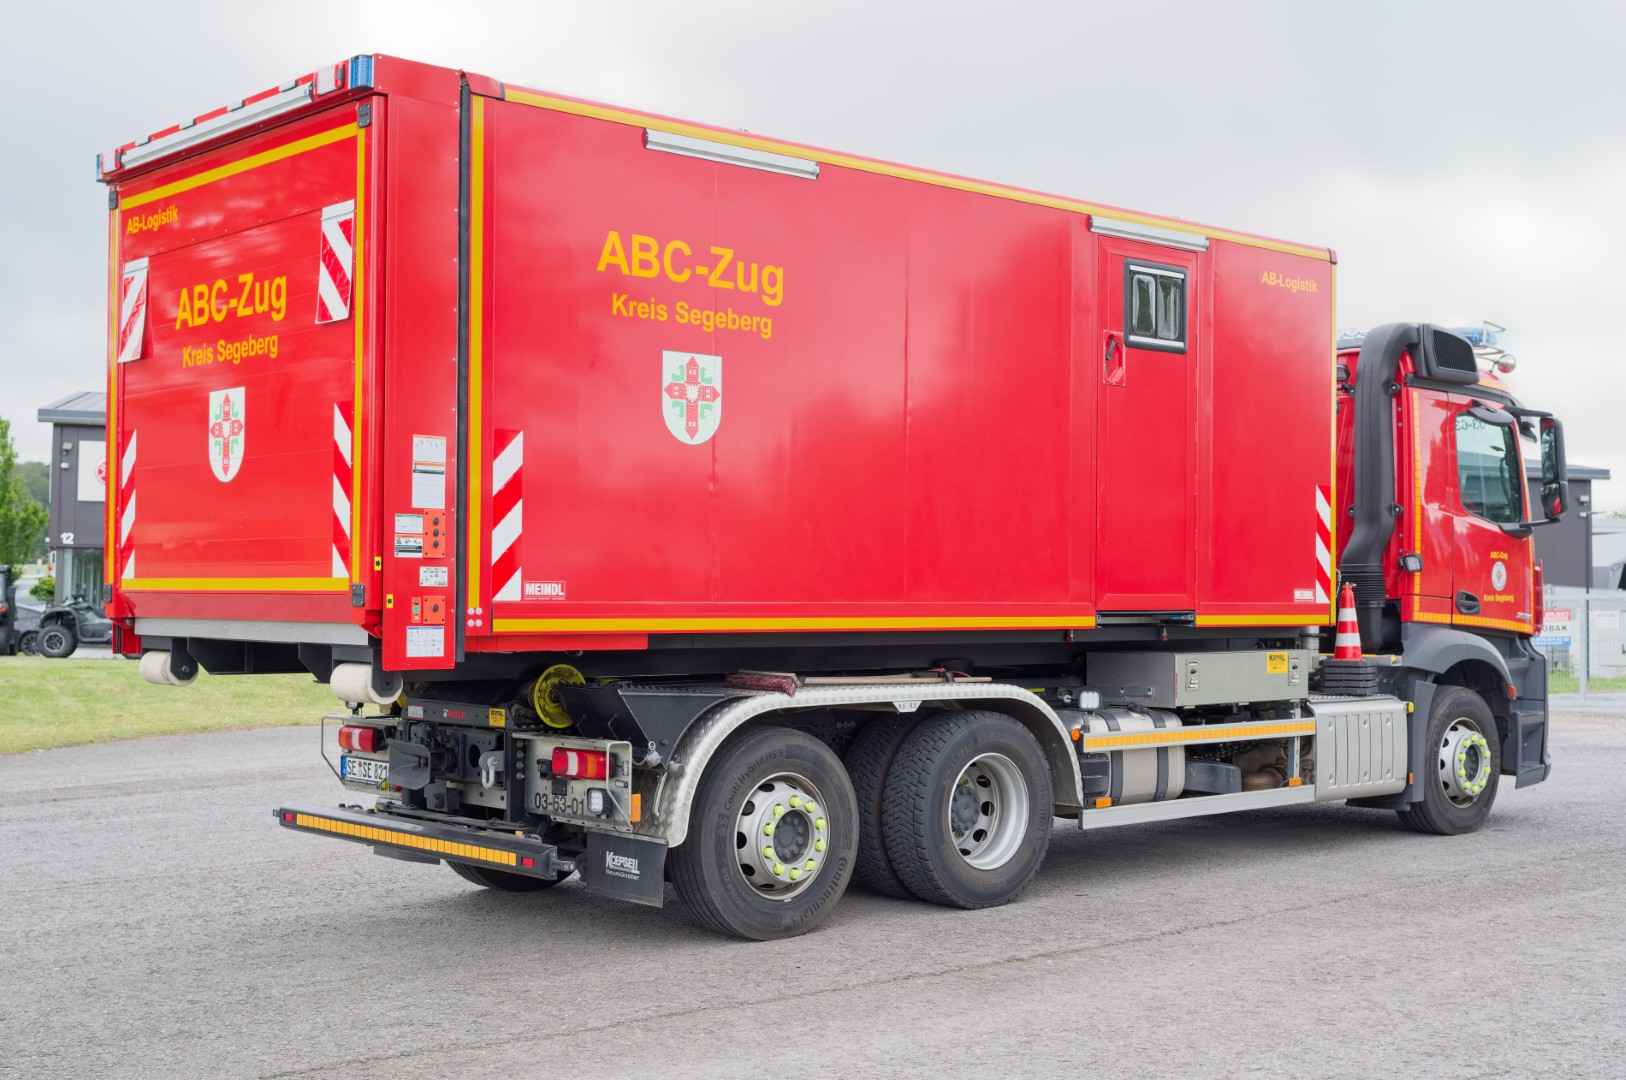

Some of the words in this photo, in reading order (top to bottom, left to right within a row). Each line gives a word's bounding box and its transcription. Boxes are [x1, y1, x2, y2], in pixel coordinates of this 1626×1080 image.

[126, 204, 178, 235] AB-Logistik
[597, 230, 784, 307] ABC-Zug
[1261, 270, 1318, 293] AB-Logistik
[175, 272, 287, 330] ABC-Zug
[612, 293, 668, 321] Kreis
[675, 301, 772, 339] Segeberg
[182, 342, 214, 368] Kreis
[217, 334, 279, 365] Segeberg
[60, 531, 75, 545] 12
[525, 583, 564, 596] MEINDL
[347, 760, 357, 776] SE
[363, 762, 372, 779] SE
[374, 763, 388, 780] 821
[535, 792, 584, 816] 03-63-01
[606, 850, 640, 874] KOEPSELL
[800, 856, 848, 923] Continental
